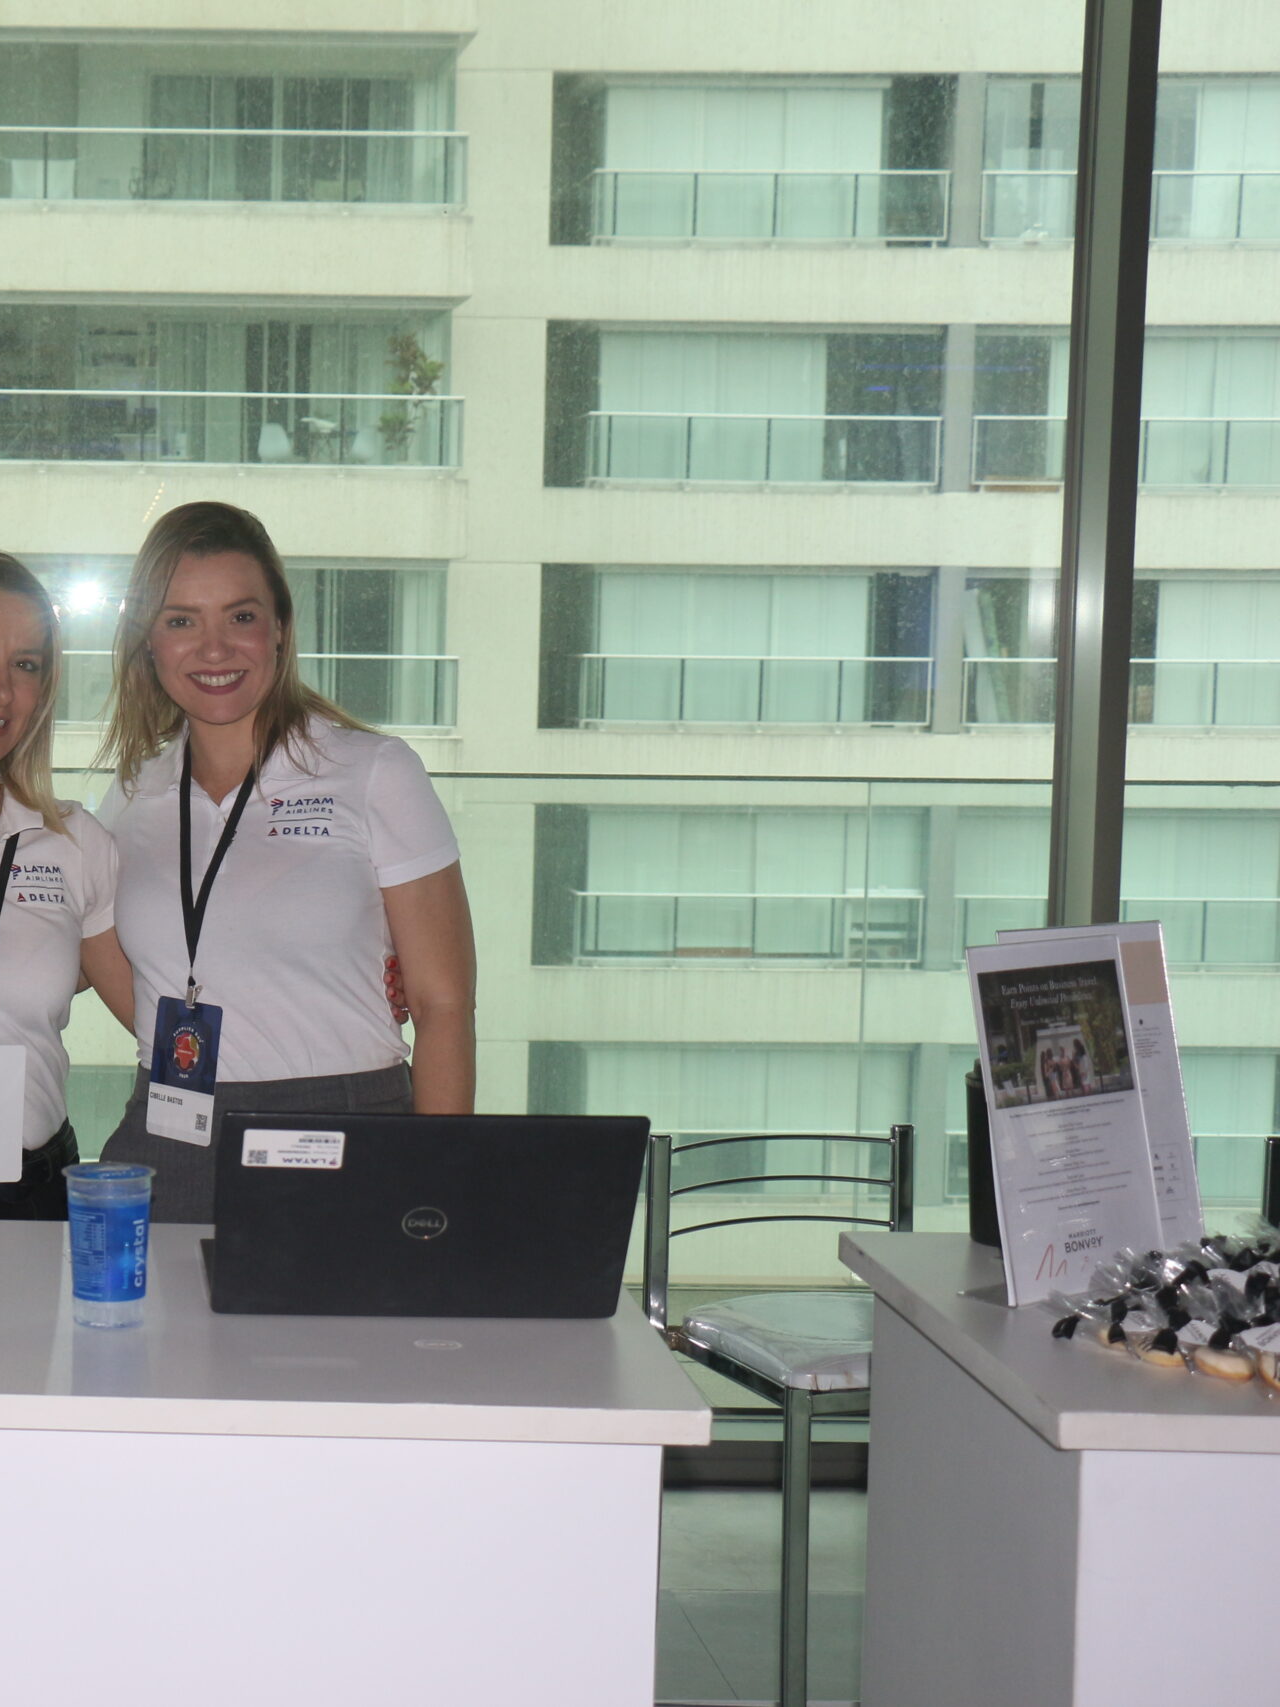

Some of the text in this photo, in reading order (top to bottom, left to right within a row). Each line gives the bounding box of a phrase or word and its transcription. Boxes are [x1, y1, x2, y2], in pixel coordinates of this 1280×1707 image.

[286, 797, 334, 807] LATAM
[285, 807, 334, 815] AIRLINES
[282, 826, 330, 837] DELTA
[23, 865, 62, 875] LATAM
[25, 875, 64, 884] AIRLINES
[1064, 1236, 1102, 1253] BONVOY
[133, 1219, 144, 1287] crystal
